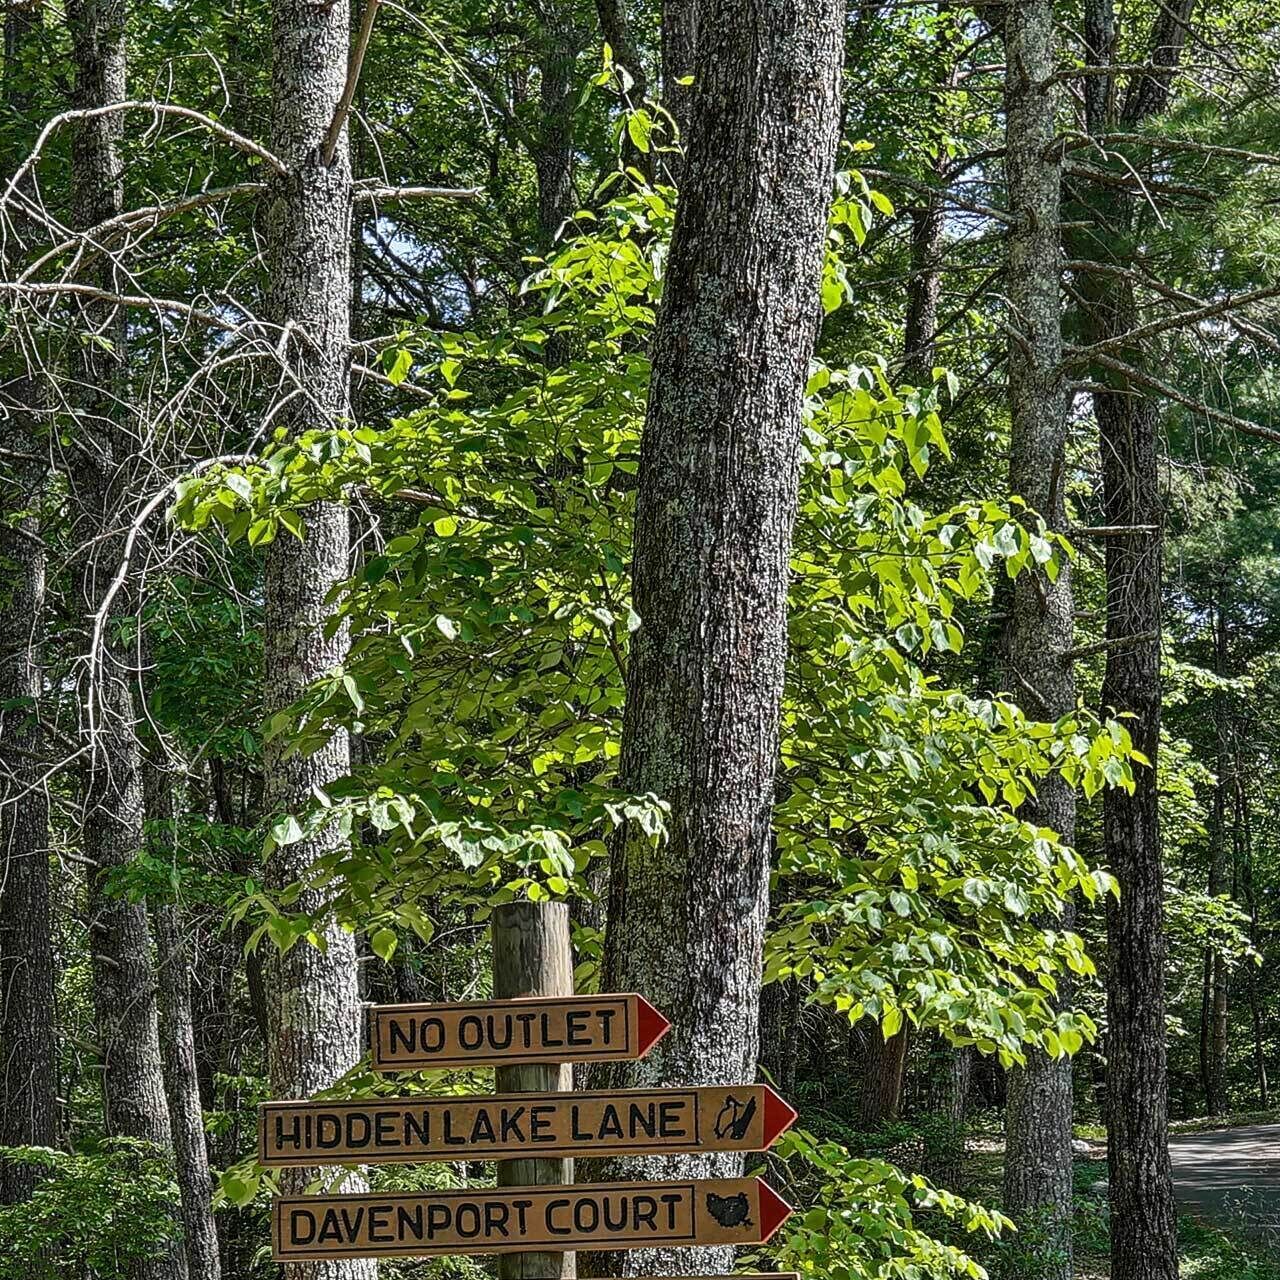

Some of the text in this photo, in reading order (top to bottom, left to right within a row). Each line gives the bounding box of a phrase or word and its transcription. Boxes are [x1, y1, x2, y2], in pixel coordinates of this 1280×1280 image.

[389, 1009, 616, 1055] NO OUTLET
[275, 1102, 686, 1150] HIDDEN LAKE LANE
[290, 1194, 681, 1246] DAVENPORT COURT
